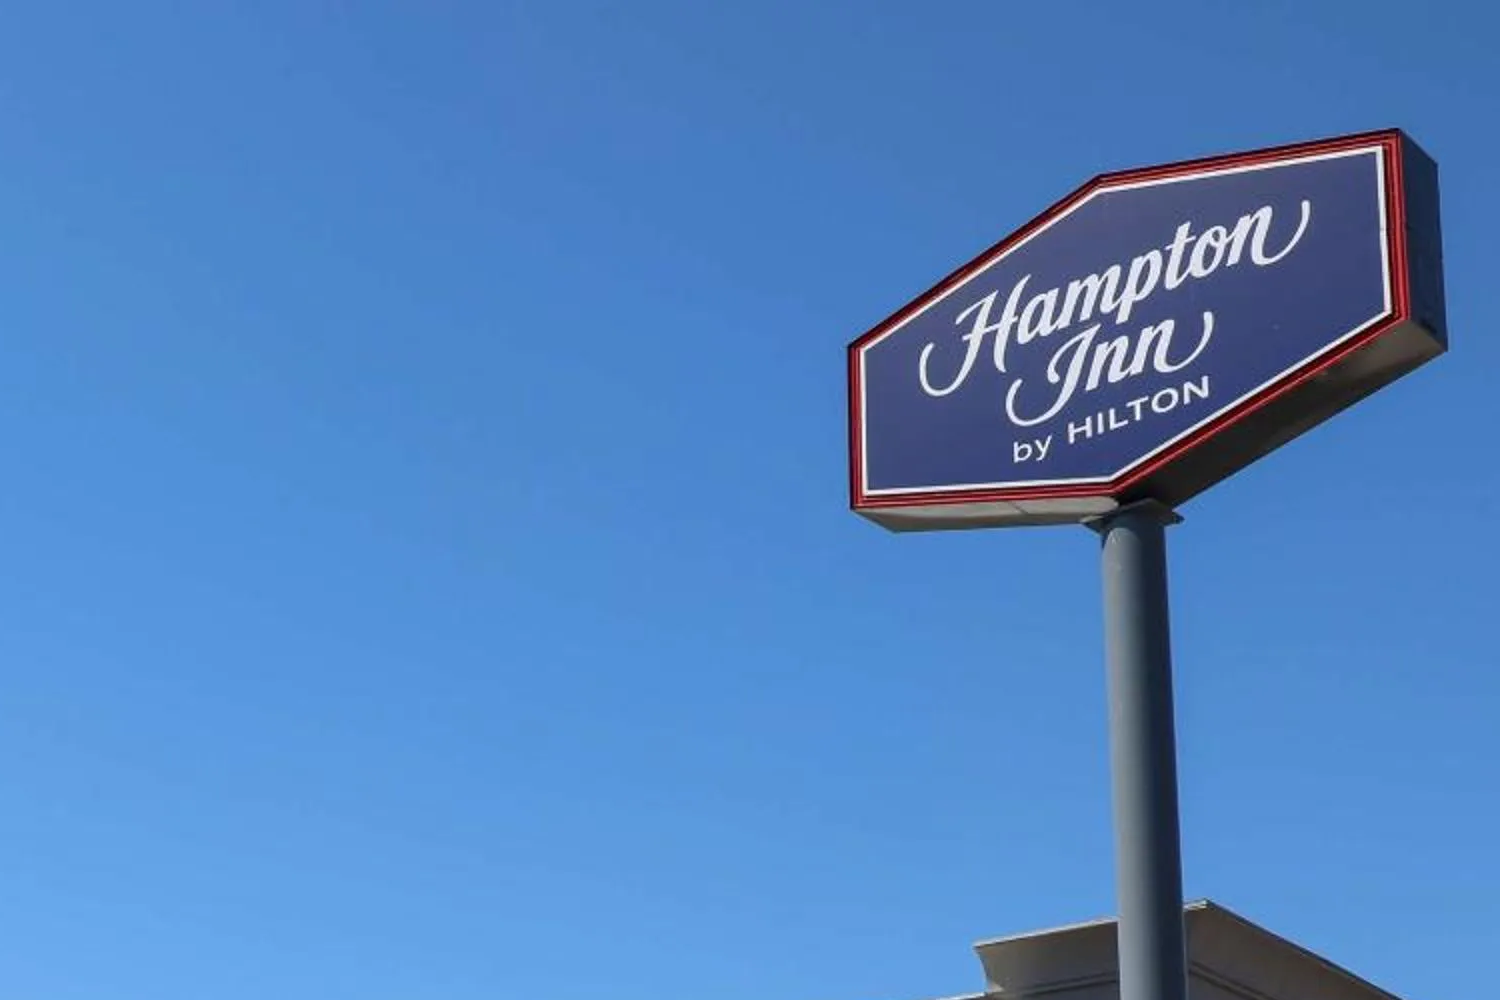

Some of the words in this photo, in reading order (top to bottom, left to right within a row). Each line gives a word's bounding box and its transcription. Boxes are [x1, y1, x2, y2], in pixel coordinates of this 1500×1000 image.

[919, 200, 1311, 397] Hampton
[1006, 311, 1214, 427] Inn
[1013, 435, 1052, 463] by
[1067, 375, 1210, 445] HILTON
